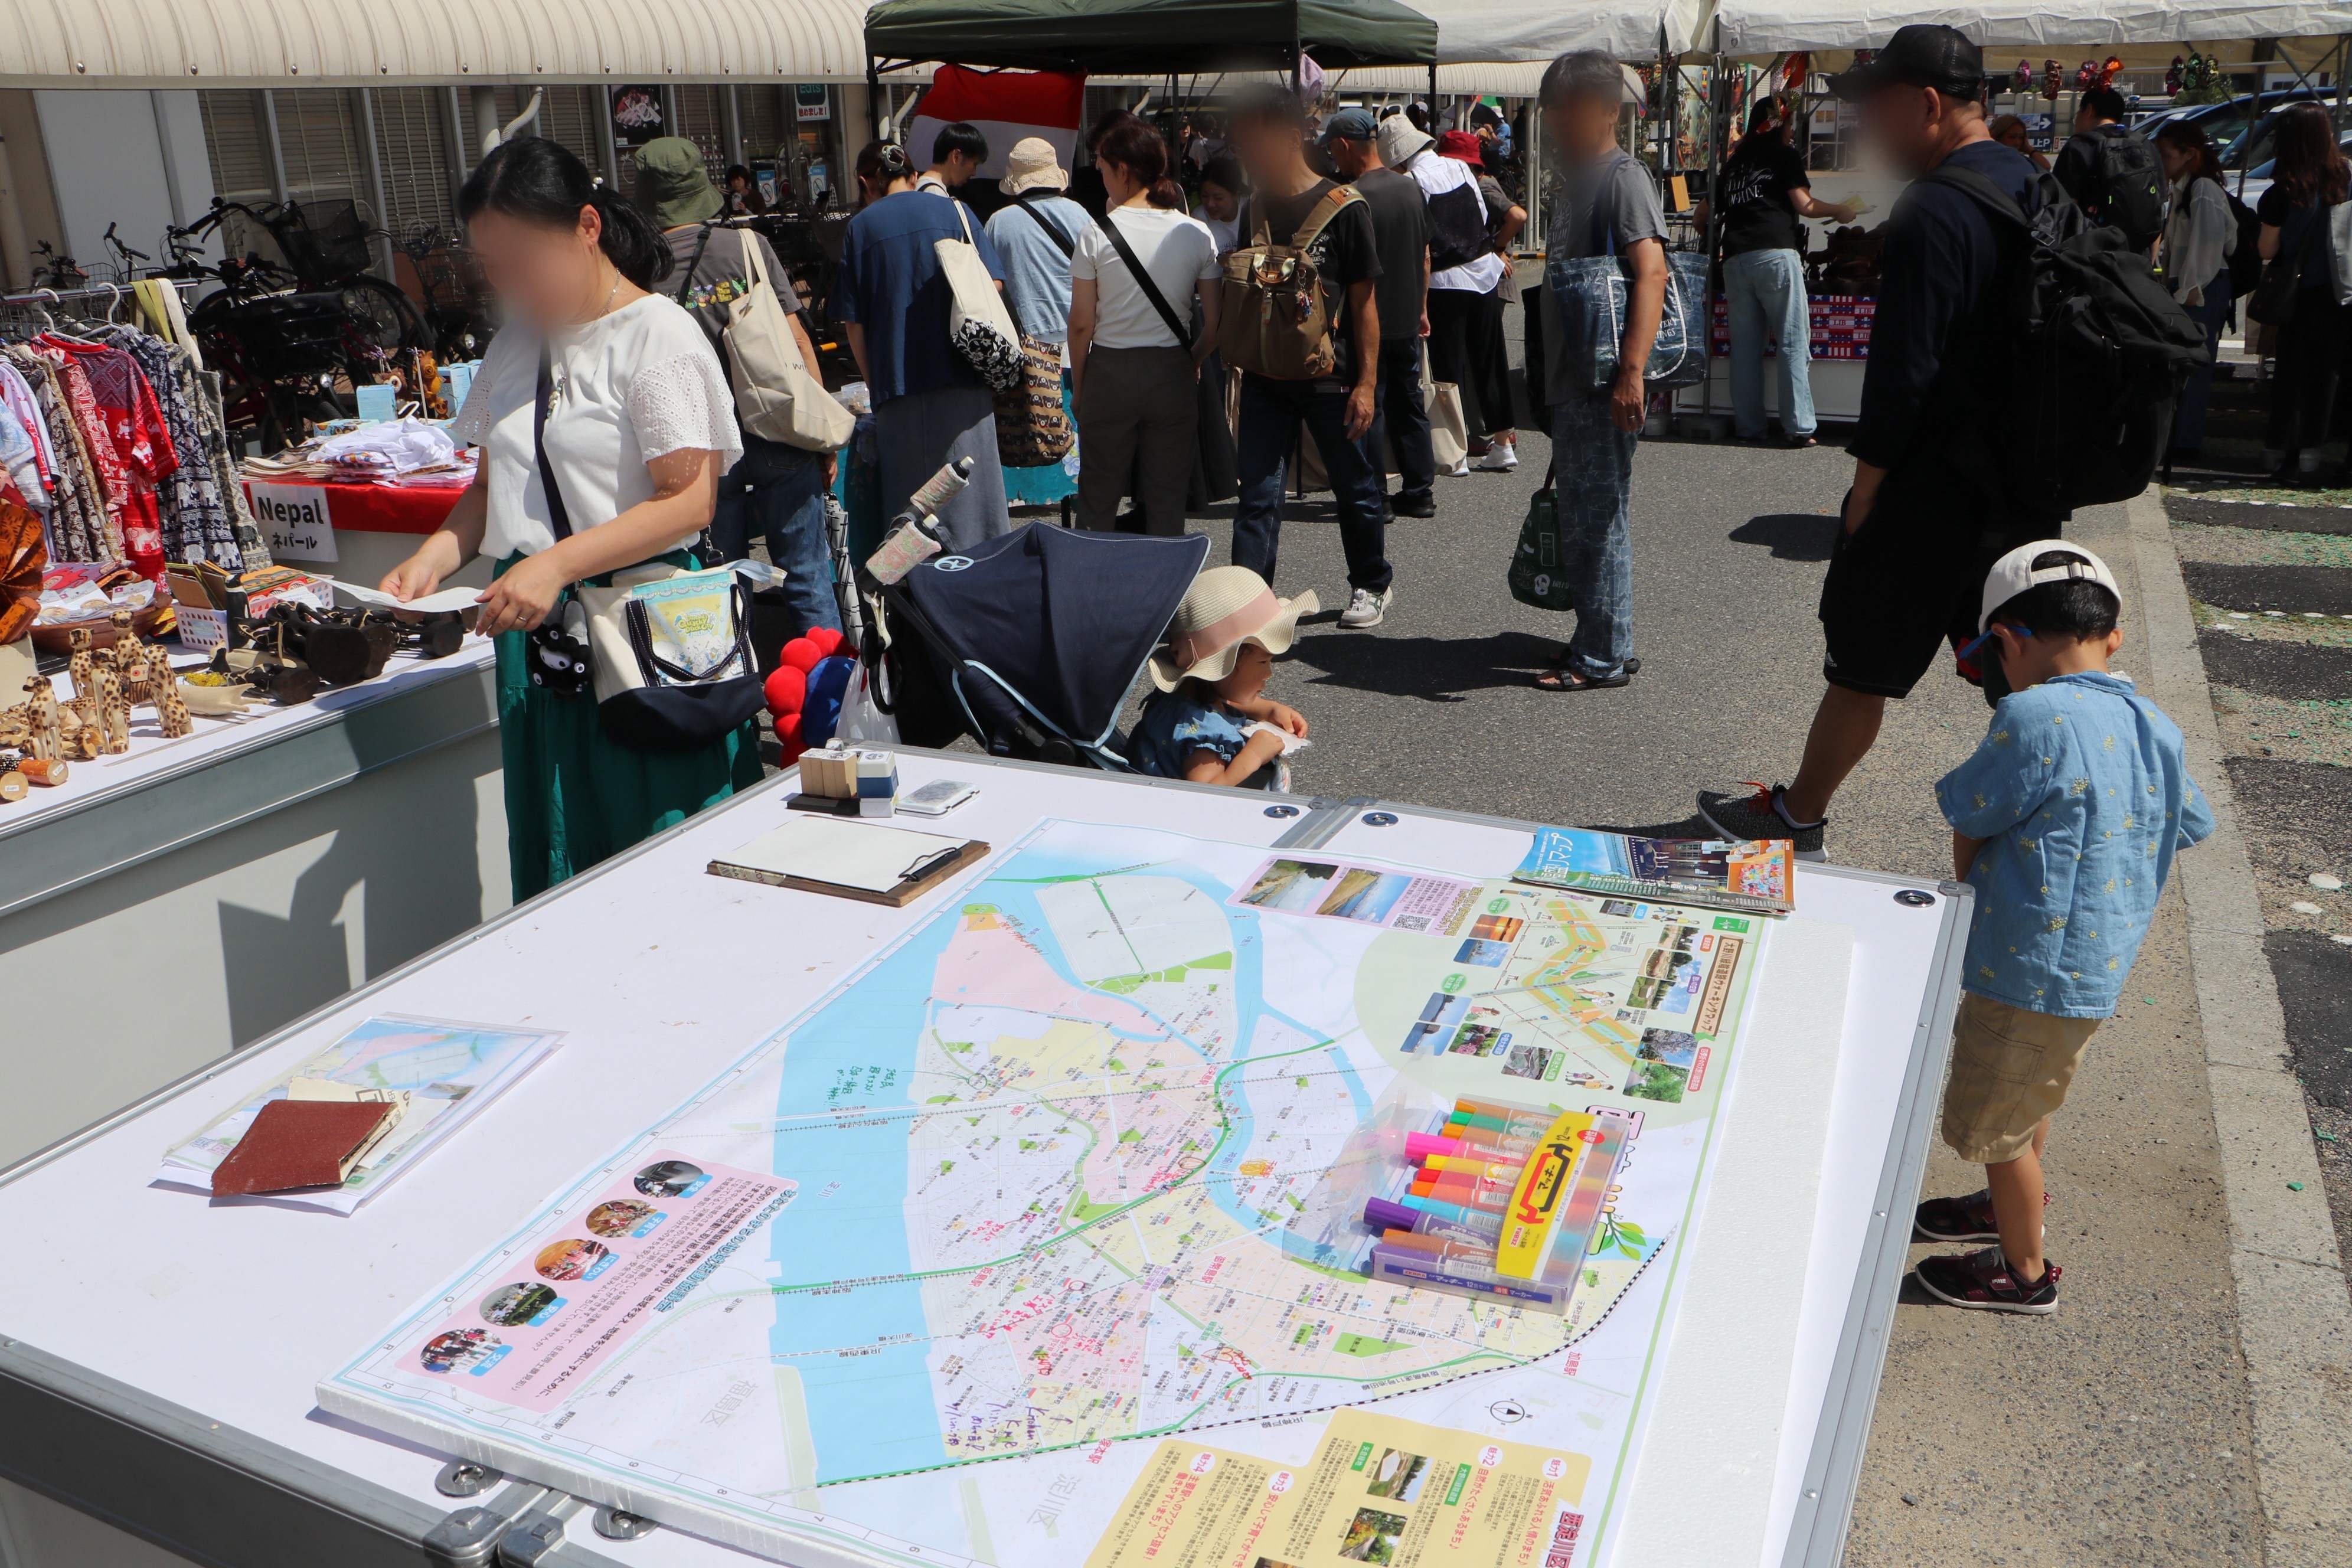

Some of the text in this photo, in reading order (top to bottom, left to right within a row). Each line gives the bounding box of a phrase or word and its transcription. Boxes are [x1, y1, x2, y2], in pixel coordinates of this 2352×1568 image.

[257, 496, 324, 528] Nepal
[272, 532, 318, 550] ネパール
[1556, 1132, 1570, 1141] 12
[1582, 1131, 1599, 1143] 油性
[684, 1180, 707, 1193] 安全
[1537, 1164, 1556, 1191] マッキー
[818, 1181, 842, 1198] 淀川
[635, 1216, 664, 1234] 子育て
[651, 1182, 766, 1279] さまざまな地域活動に取り組んでいます。
[1511, 1227, 1523, 1246] ZEBRA
[650, 1188, 800, 1315] あなたのまちの地域活動協議会
[582, 1255, 619, 1280] にぎわい
[967, 1266, 995, 1288] 姫島駅
[1198, 1255, 1227, 1284] 御幣島駅
[810, 1287, 852, 1296] 阪神本線
[1403, 1269, 1426, 1279] ZEBRA
[1435, 1274, 1463, 1286] マッキー
[1494, 1286, 1509, 1295] 油性
[1510, 1288, 1532, 1298] マーカー
[534, 1304, 562, 1320] 安心
[720, 1297, 744, 1314] 淀川駅
[478, 1352, 507, 1369] 交流
[837, 1348, 881, 1358] JR東西線
[943, 1355, 964, 1374] 西成大橋
[1562, 1350, 1582, 1377] 加島駅
[384, 1382, 393, 1391] 12
[602, 1373, 636, 1398] 海老江駅
[464, 1407, 475, 1416] 11
[696, 1379, 760, 1429] 福島区
[548, 1410, 577, 1430] 野田駅
[1257, 1416, 1307, 1429] JR神戸線
[541, 1433, 552, 1442] 10
[1084, 1437, 1113, 1465] 塚本駅
[1481, 1445, 1500, 1466] 魅力2
[1190, 1452, 1213, 1474] 魅力4
[1544, 1458, 1563, 1478] 魅力1
[1269, 1471, 1291, 1492] 魅力3
[1024, 1472, 1082, 1530] 淀川区
